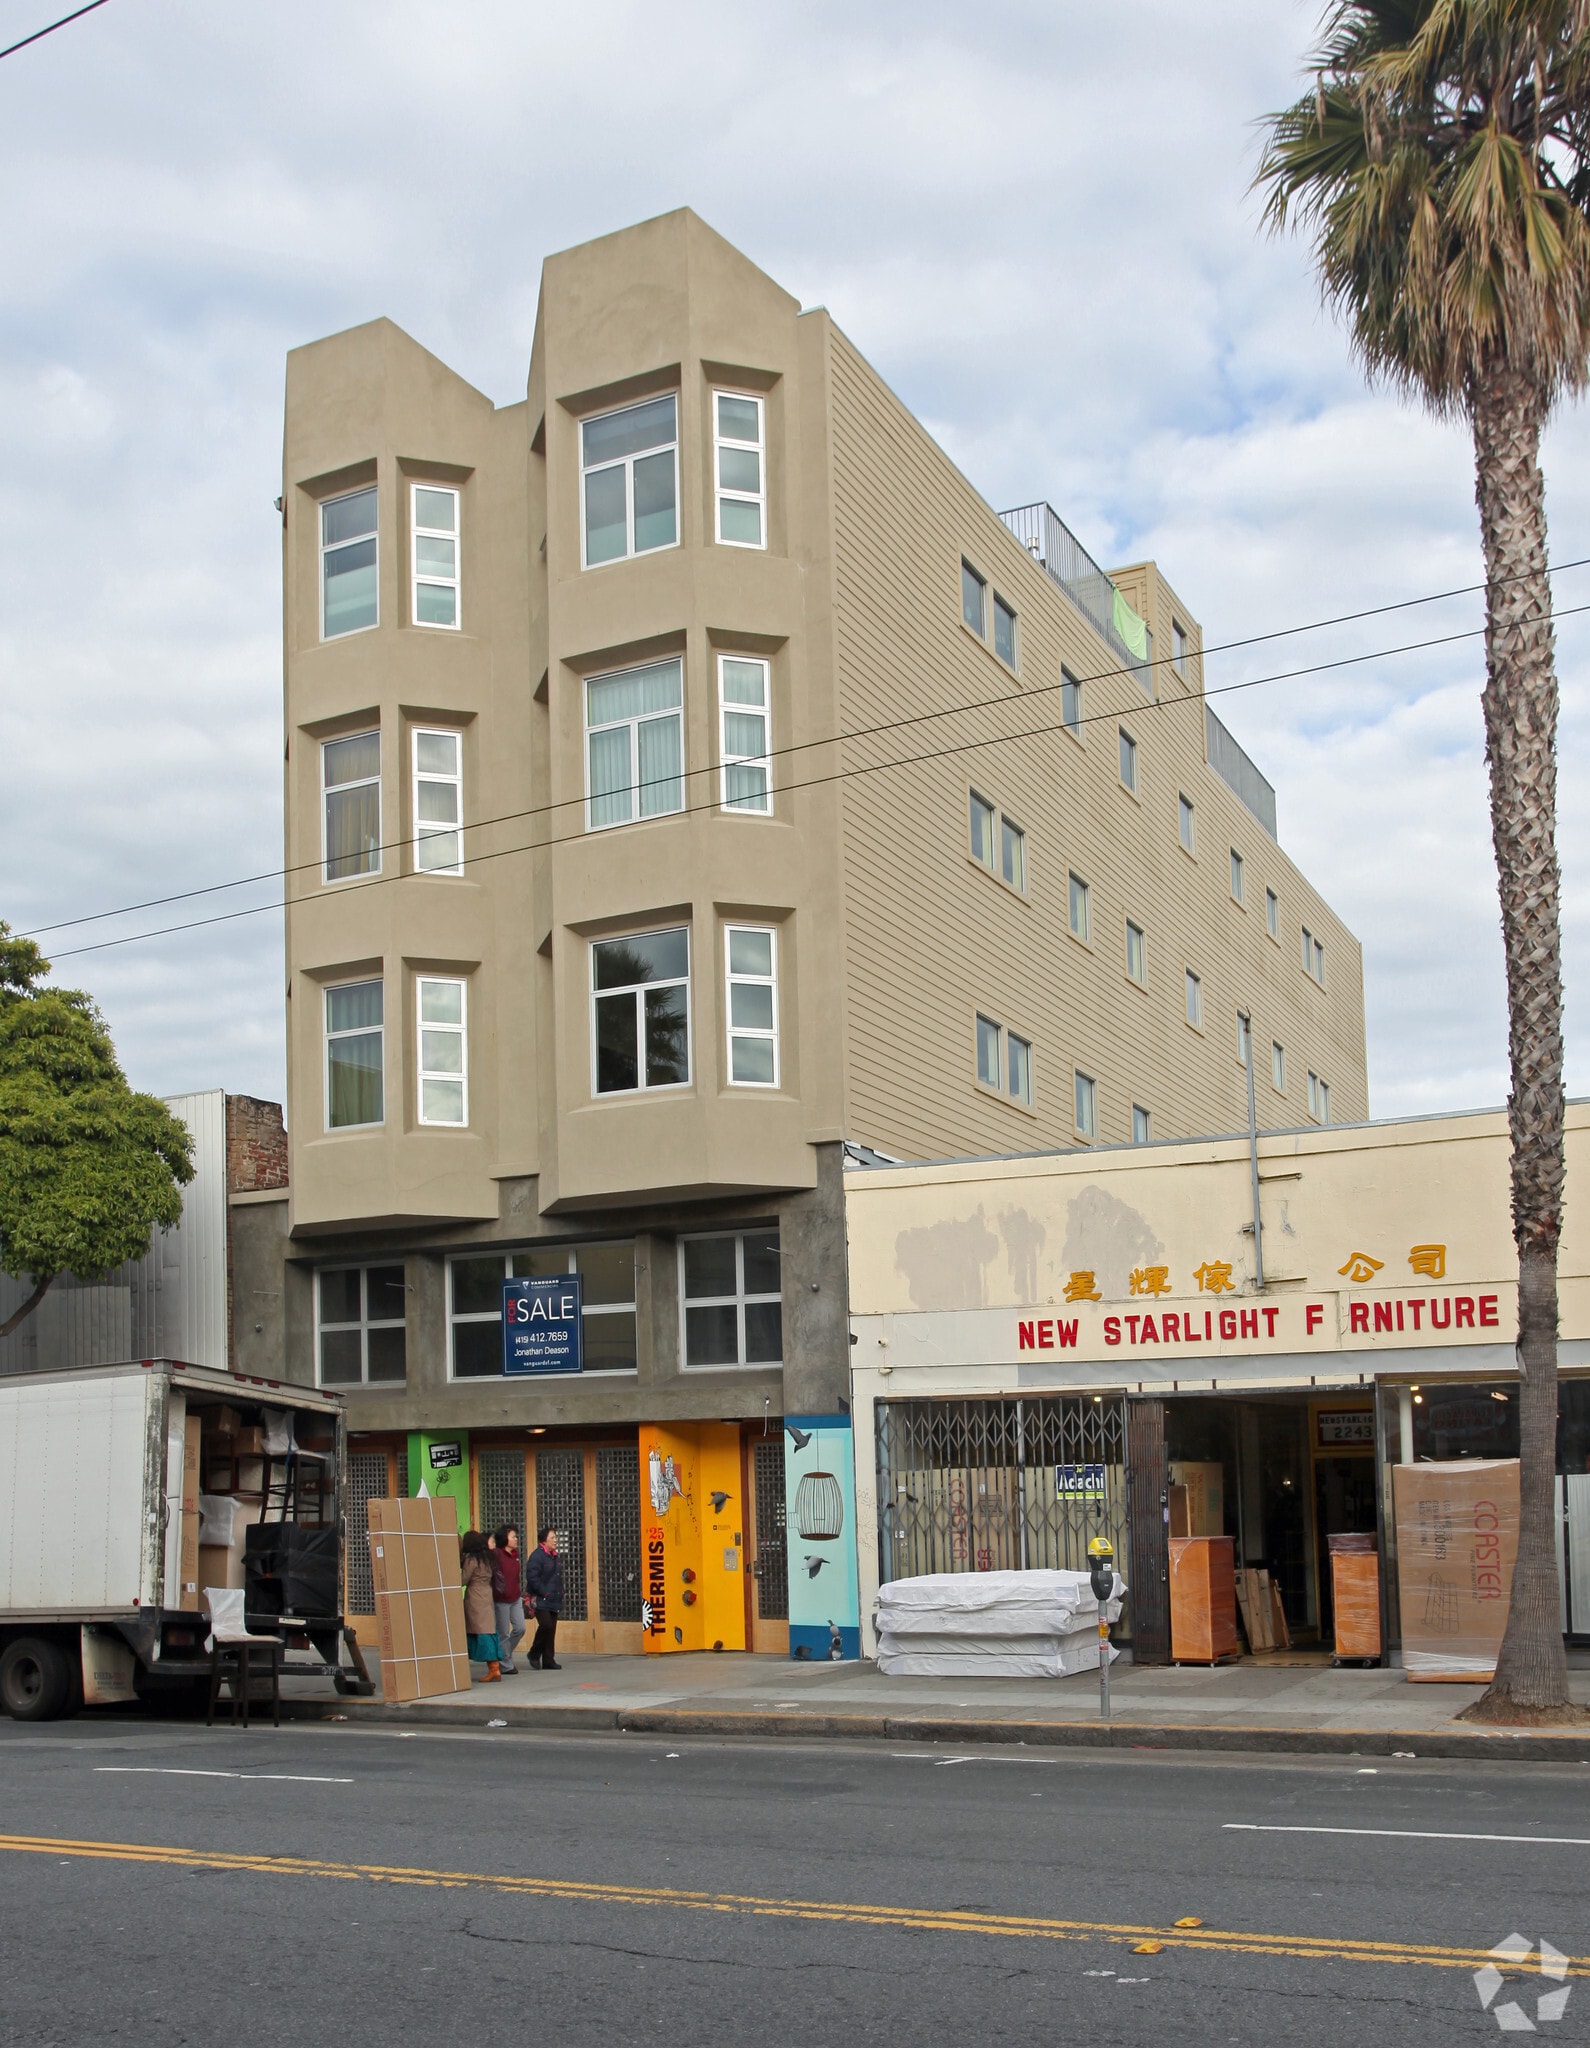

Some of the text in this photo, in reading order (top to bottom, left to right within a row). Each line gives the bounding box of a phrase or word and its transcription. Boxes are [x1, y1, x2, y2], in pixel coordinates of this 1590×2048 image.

[507, 1299, 516, 1323] FOR
[517, 1296, 574, 1322] SALE
[530, 1331, 568, 1343] 412.7659
[1018, 1319, 1079, 1349] NEW
[1104, 1307, 1279, 1346] STARLIGHT
[514, 1346, 569, 1357] Jonathan Deason
[1335, 1426, 1372, 1438] 2243
[1058, 1472, 1105, 1490] Adachi
[950, 1478, 968, 1560] COASTER
[1473, 1501, 1502, 1600] COASTER
[649, 1541, 666, 1636] THERMIS
